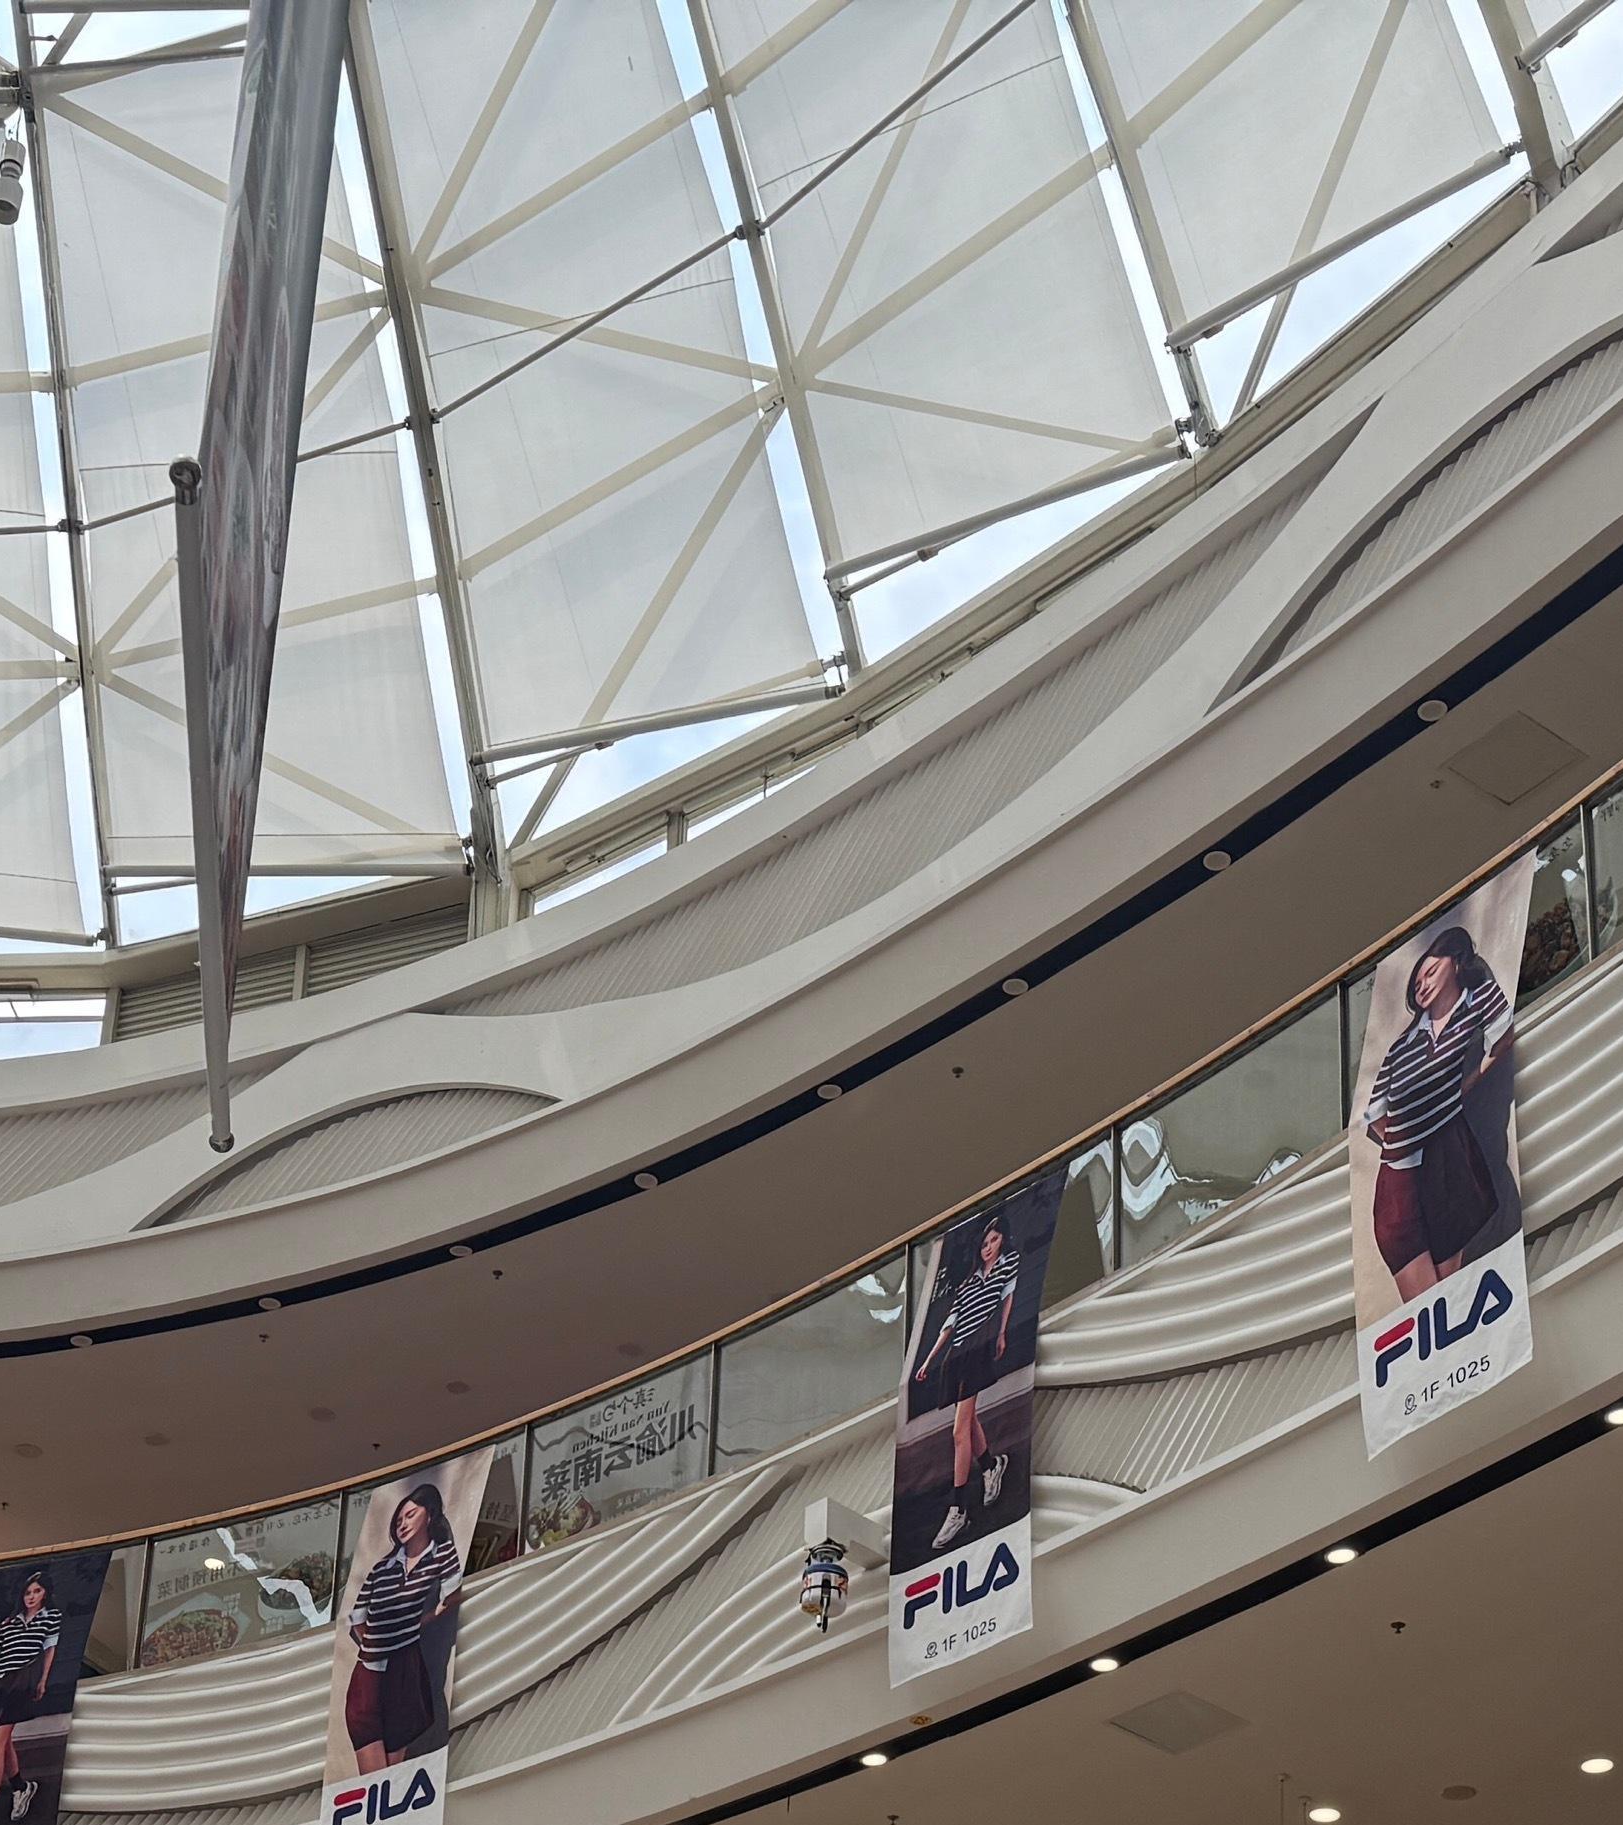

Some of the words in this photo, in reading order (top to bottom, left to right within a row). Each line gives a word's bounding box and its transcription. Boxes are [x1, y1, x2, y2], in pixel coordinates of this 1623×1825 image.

[1374, 1266, 1513, 1388] FILA
[1422, 1381, 1439, 1401] 1F
[1447, 1355, 1491, 1395] 1025
[903, 1541, 1019, 1629] FILA
[943, 1634, 956, 1651] 1F
[963, 1617, 997, 1647] 1025
